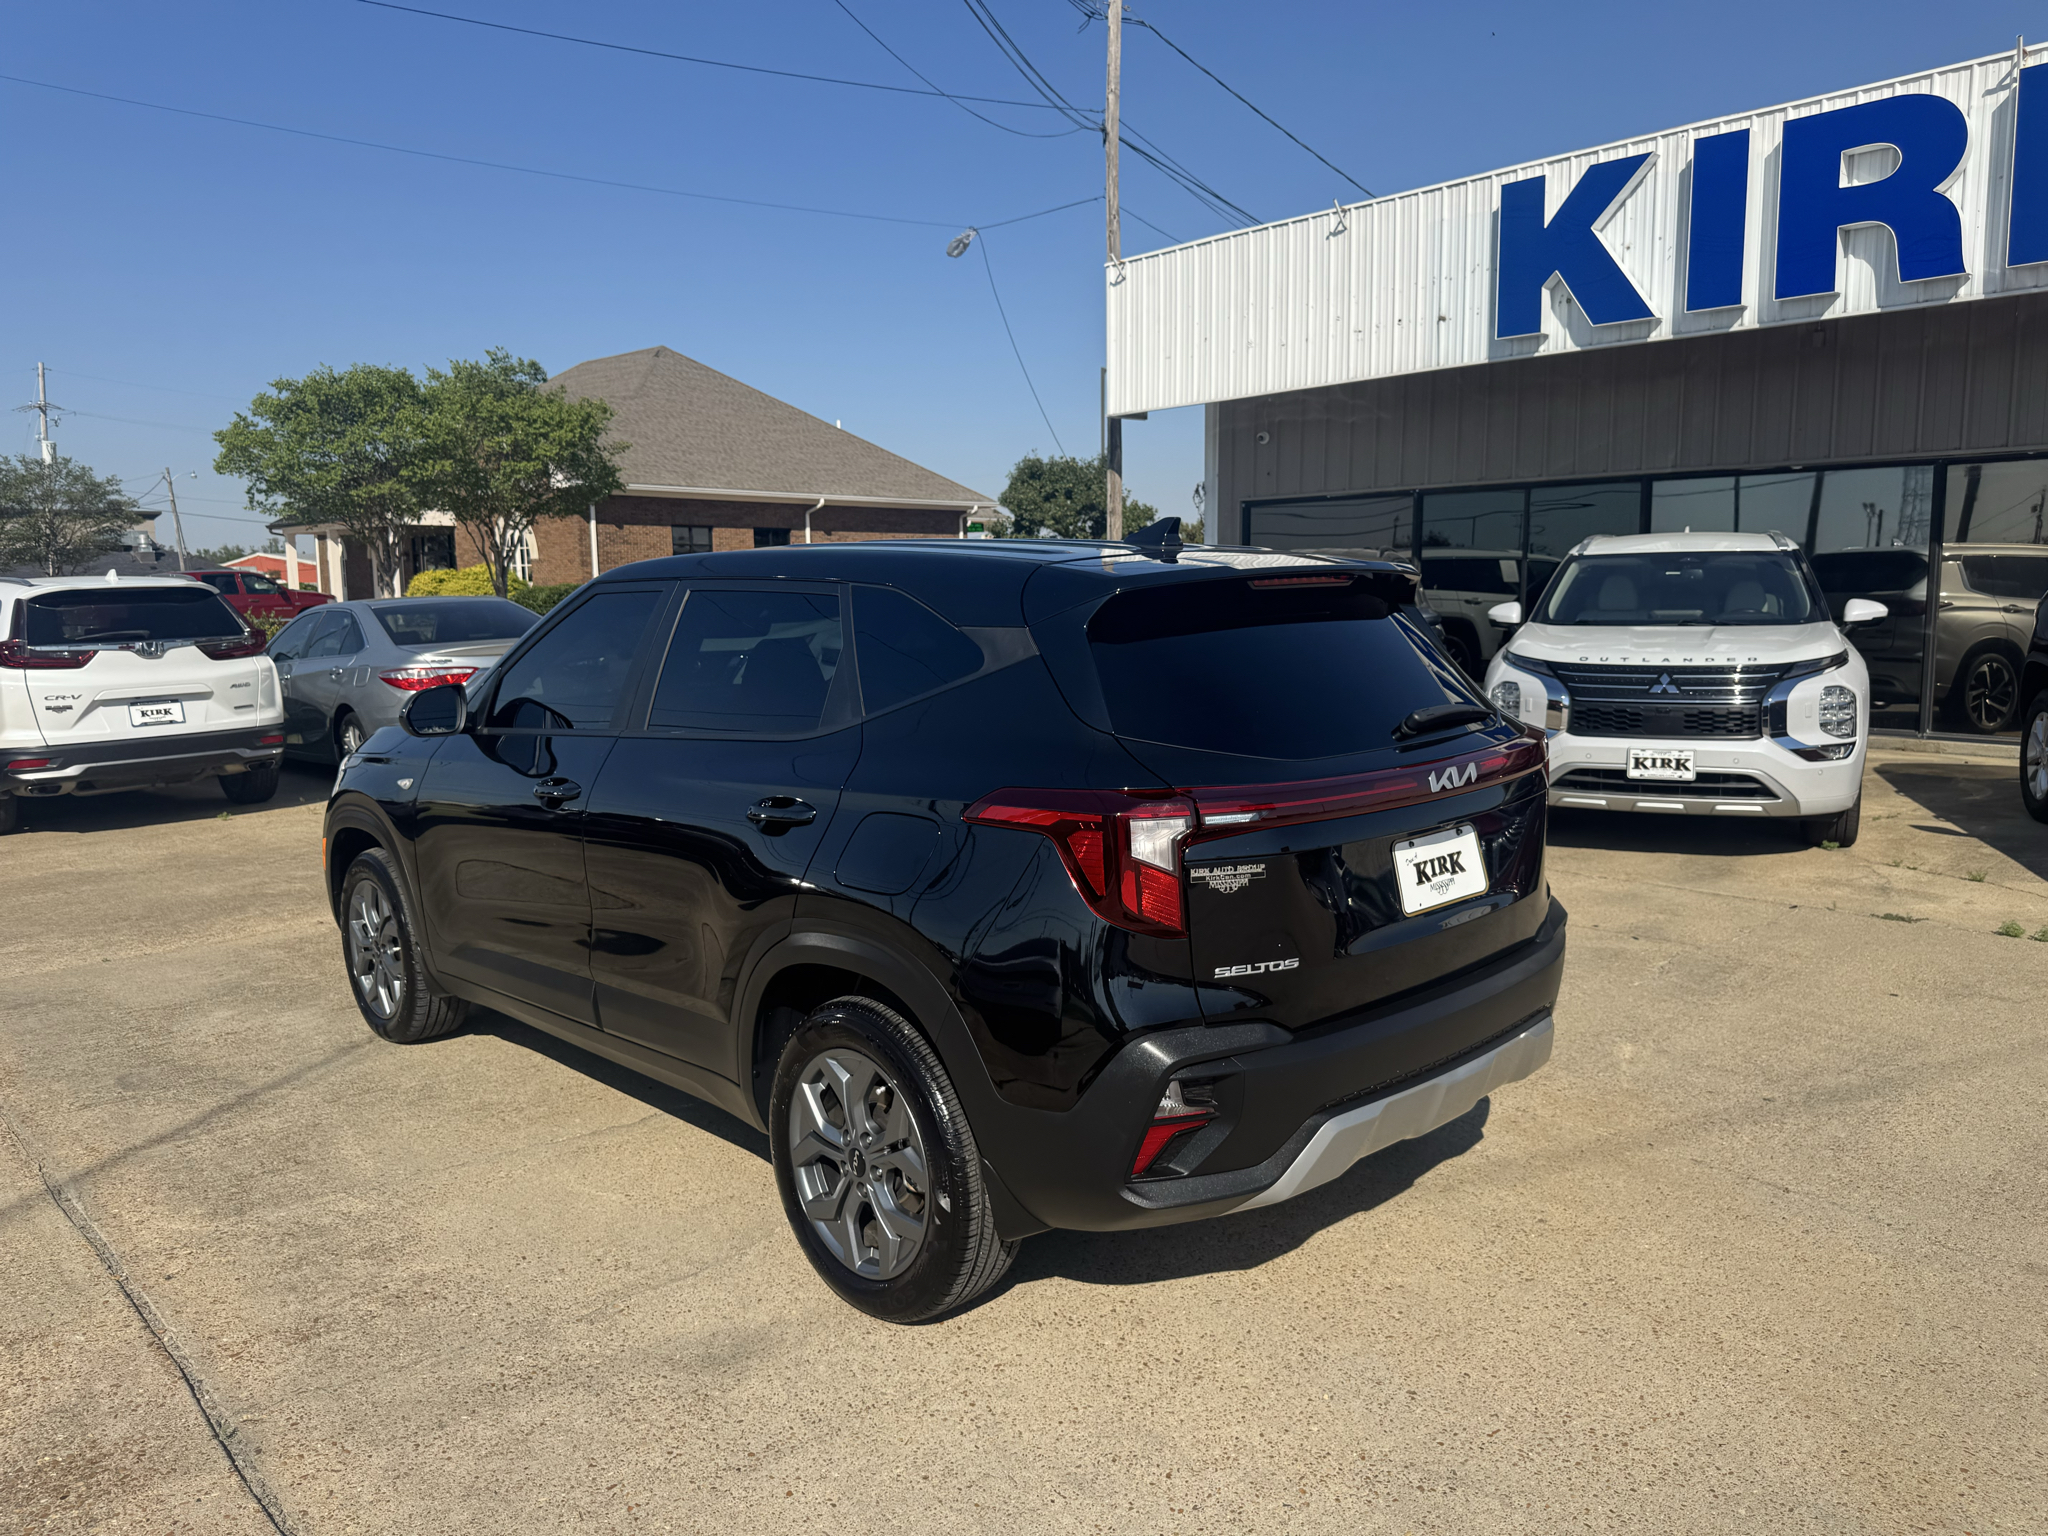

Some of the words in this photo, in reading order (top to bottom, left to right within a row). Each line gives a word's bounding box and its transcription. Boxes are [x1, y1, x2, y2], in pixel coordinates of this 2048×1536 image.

[1495, 62, 2048, 340] KIR
[140, 707, 173, 718] KIRK
[1631, 756, 1692, 772] KIRK
[1428, 762, 1478, 793] KIA
[1190, 868, 1210, 877] KIRK
[1213, 866, 1235, 875] AUTO
[1413, 850, 1467, 886] KIRK
[1214, 958, 1300, 979] SELTOS
